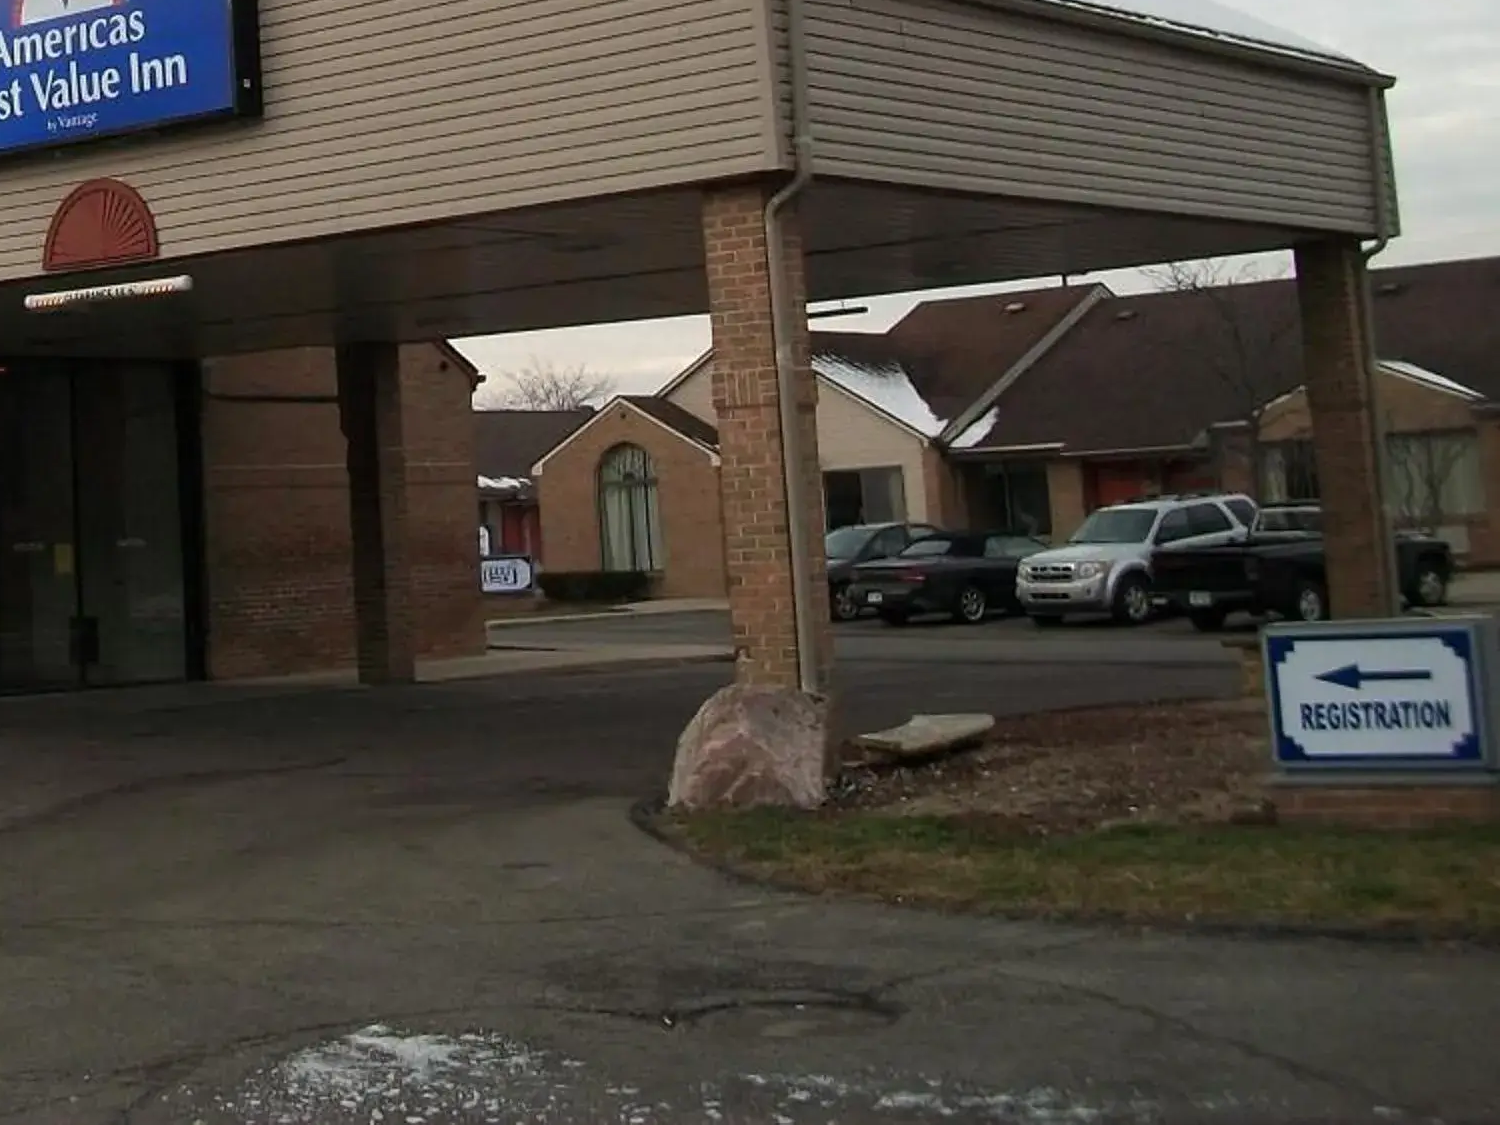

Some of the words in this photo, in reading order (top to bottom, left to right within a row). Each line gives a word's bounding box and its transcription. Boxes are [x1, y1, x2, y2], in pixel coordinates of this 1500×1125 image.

[30, 61, 120, 111] Value
[130, 52, 188, 94] Inn
[1300, 700, 1451, 730] REGISTRATION
